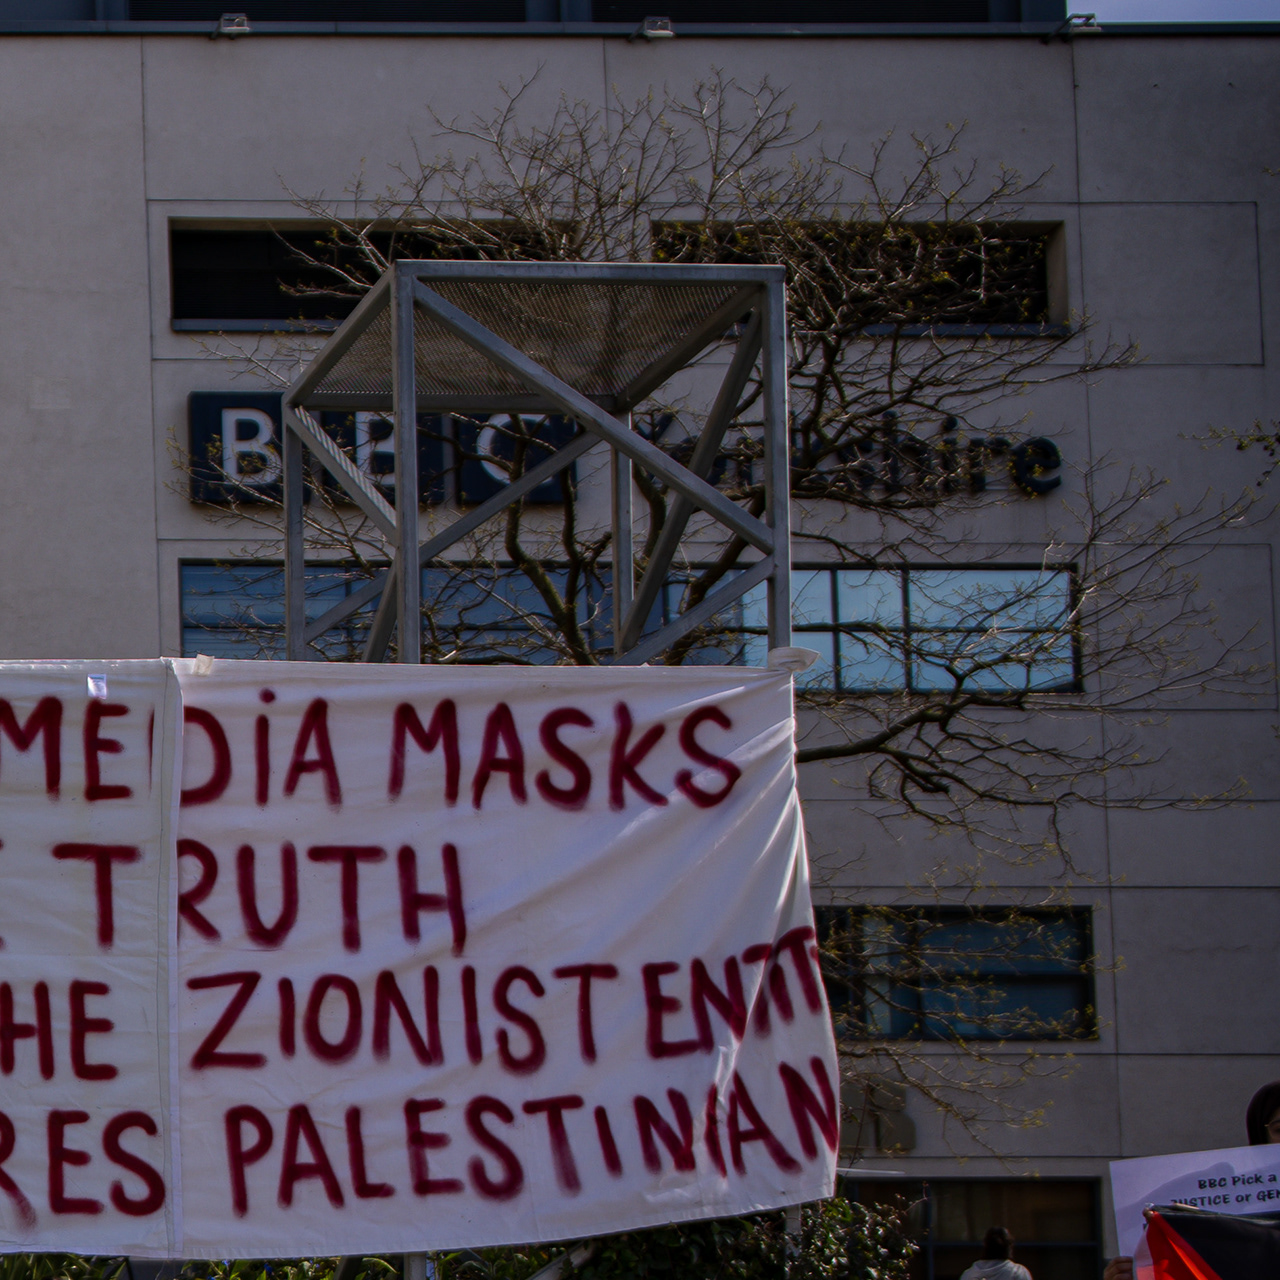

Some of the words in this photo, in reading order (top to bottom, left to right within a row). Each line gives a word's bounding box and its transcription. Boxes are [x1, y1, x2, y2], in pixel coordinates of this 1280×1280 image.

[387, 698, 741, 812] MASKS
[51, 838, 468, 957] TRUTH
[186, 964, 620, 1074] ZIONIST
[642, 924, 820, 1060] ENTIT
[224, 1055, 839, 1218] PALESTINIAN
[1197, 1177, 1227, 1190] BBC
[1231, 1172, 1264, 1186] Pick
[1268, 1174, 1277, 1182] a
[1235, 1193, 1252, 1203] or
